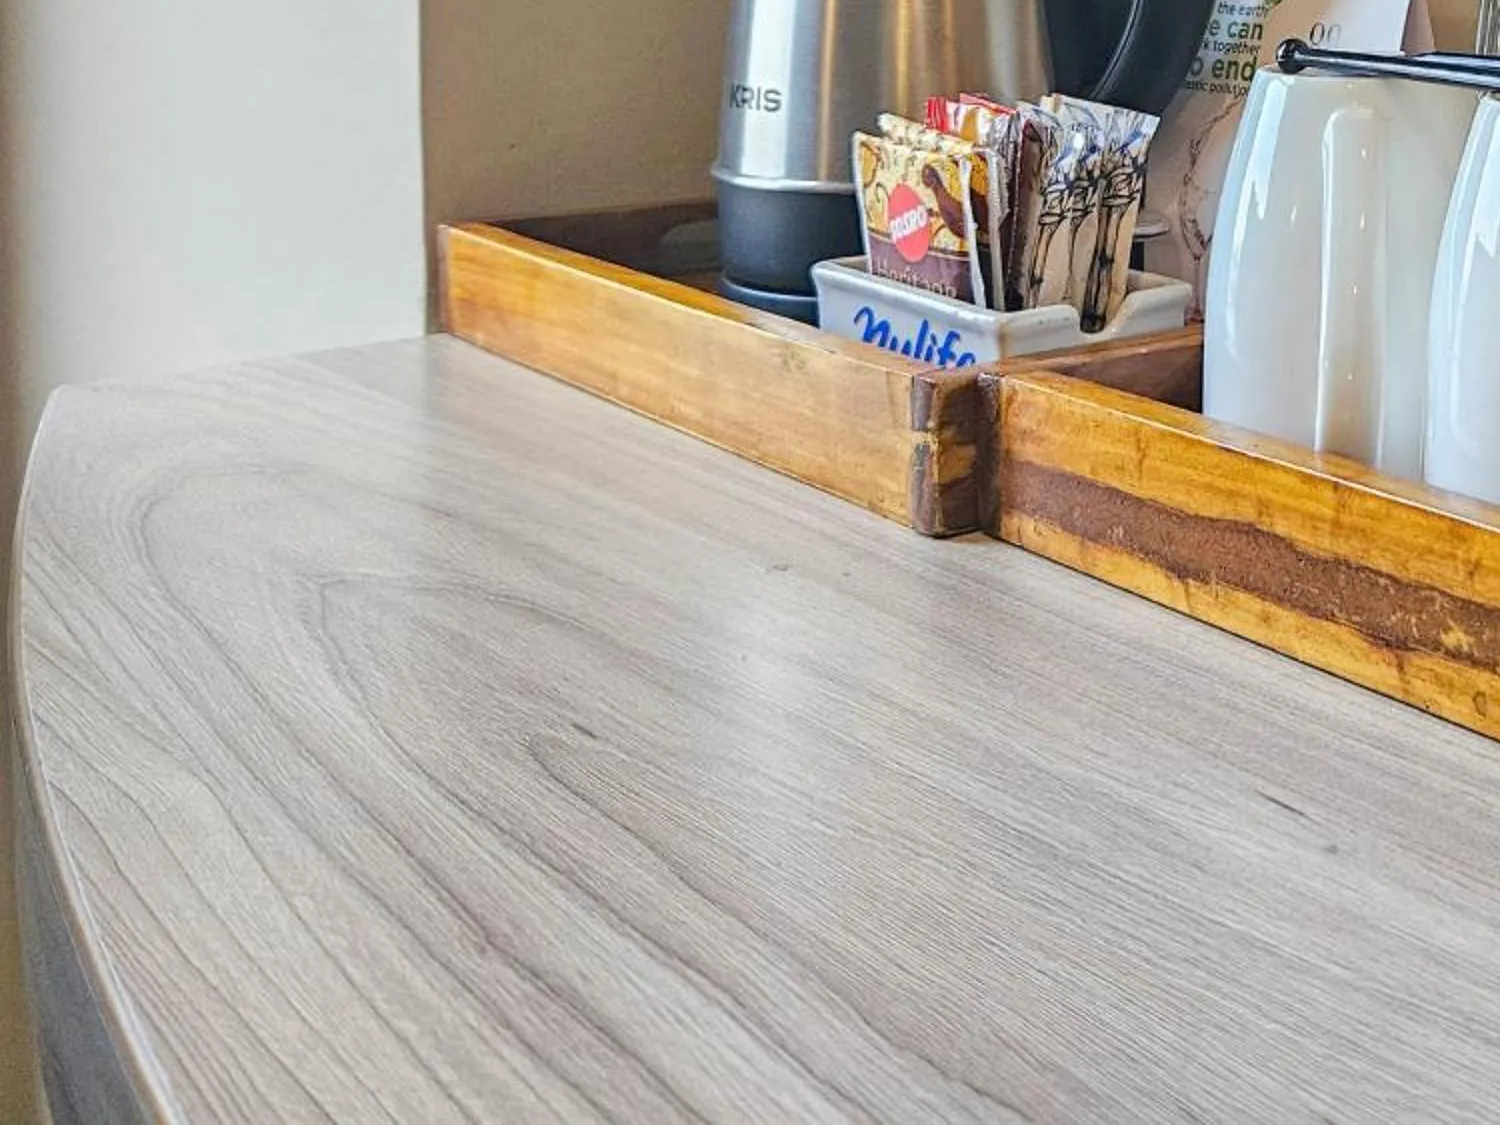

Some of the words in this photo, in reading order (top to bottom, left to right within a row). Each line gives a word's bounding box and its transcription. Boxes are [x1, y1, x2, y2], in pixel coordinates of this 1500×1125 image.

[1218, 1, 1237, 15] the
[1227, 21, 1264, 41] can
[1211, 55, 1258, 82] end
[729, 84, 782, 113] KRIS
